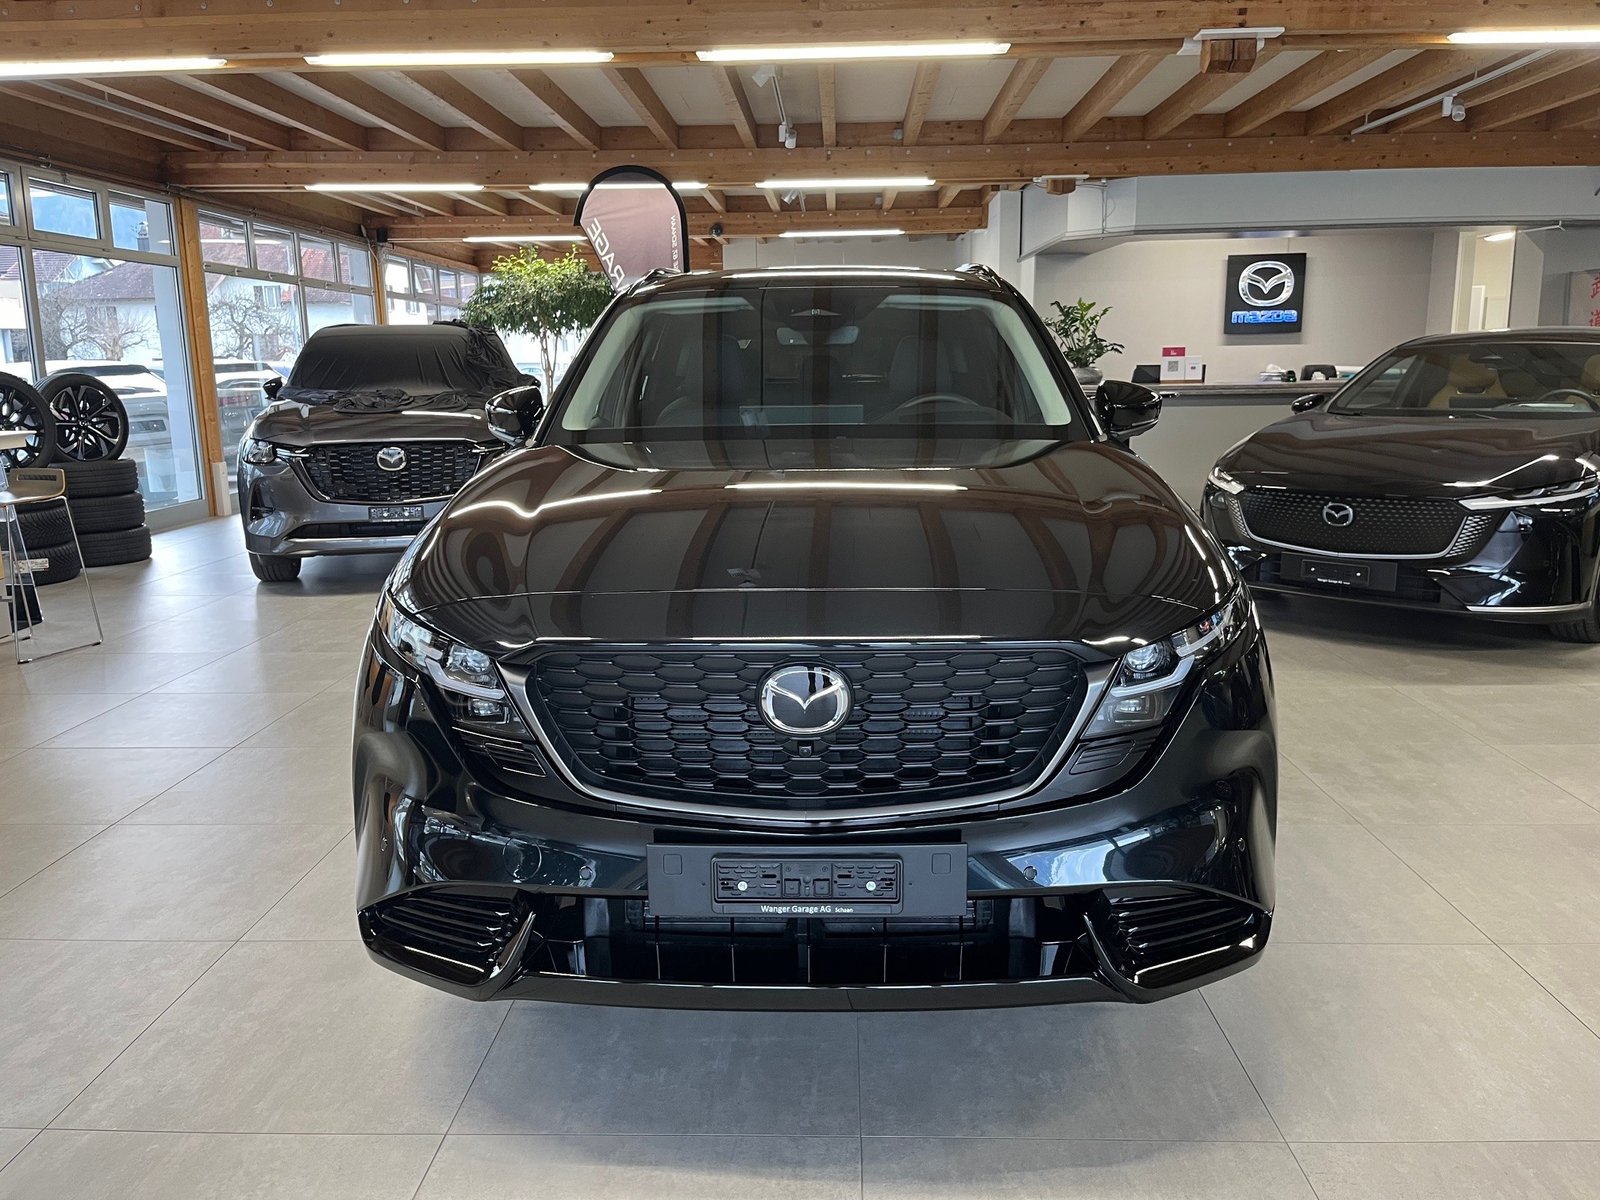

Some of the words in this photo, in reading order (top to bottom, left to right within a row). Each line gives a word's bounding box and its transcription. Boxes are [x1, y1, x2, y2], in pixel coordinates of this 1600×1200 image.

[1231, 310, 1298, 324] mazda
[760, 904, 790, 914] Wanger
[791, 904, 819, 914] Garage
[819, 904, 832, 913] AG
